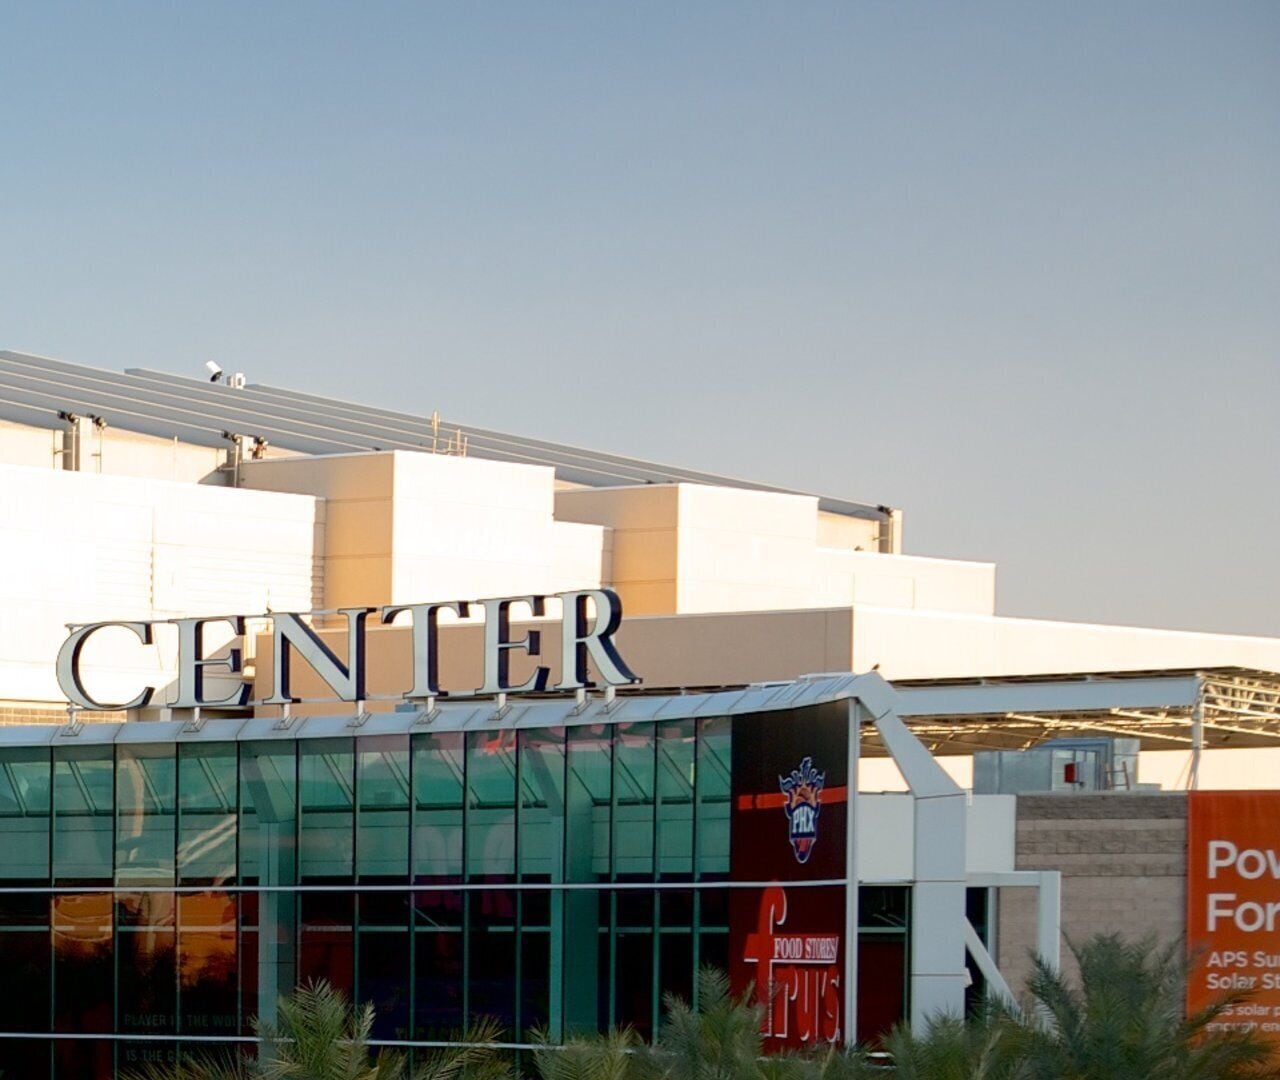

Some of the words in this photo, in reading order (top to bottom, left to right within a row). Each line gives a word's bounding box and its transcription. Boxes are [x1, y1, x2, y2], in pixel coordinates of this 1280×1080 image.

[56, 587, 643, 710] CENTER
[792, 806, 815, 835] PHX
[773, 938, 803, 959] FOOD
[805, 937, 837, 959] STORES
[1207, 952, 1248, 968] APS
[1206, 973, 1257, 989] Solar
